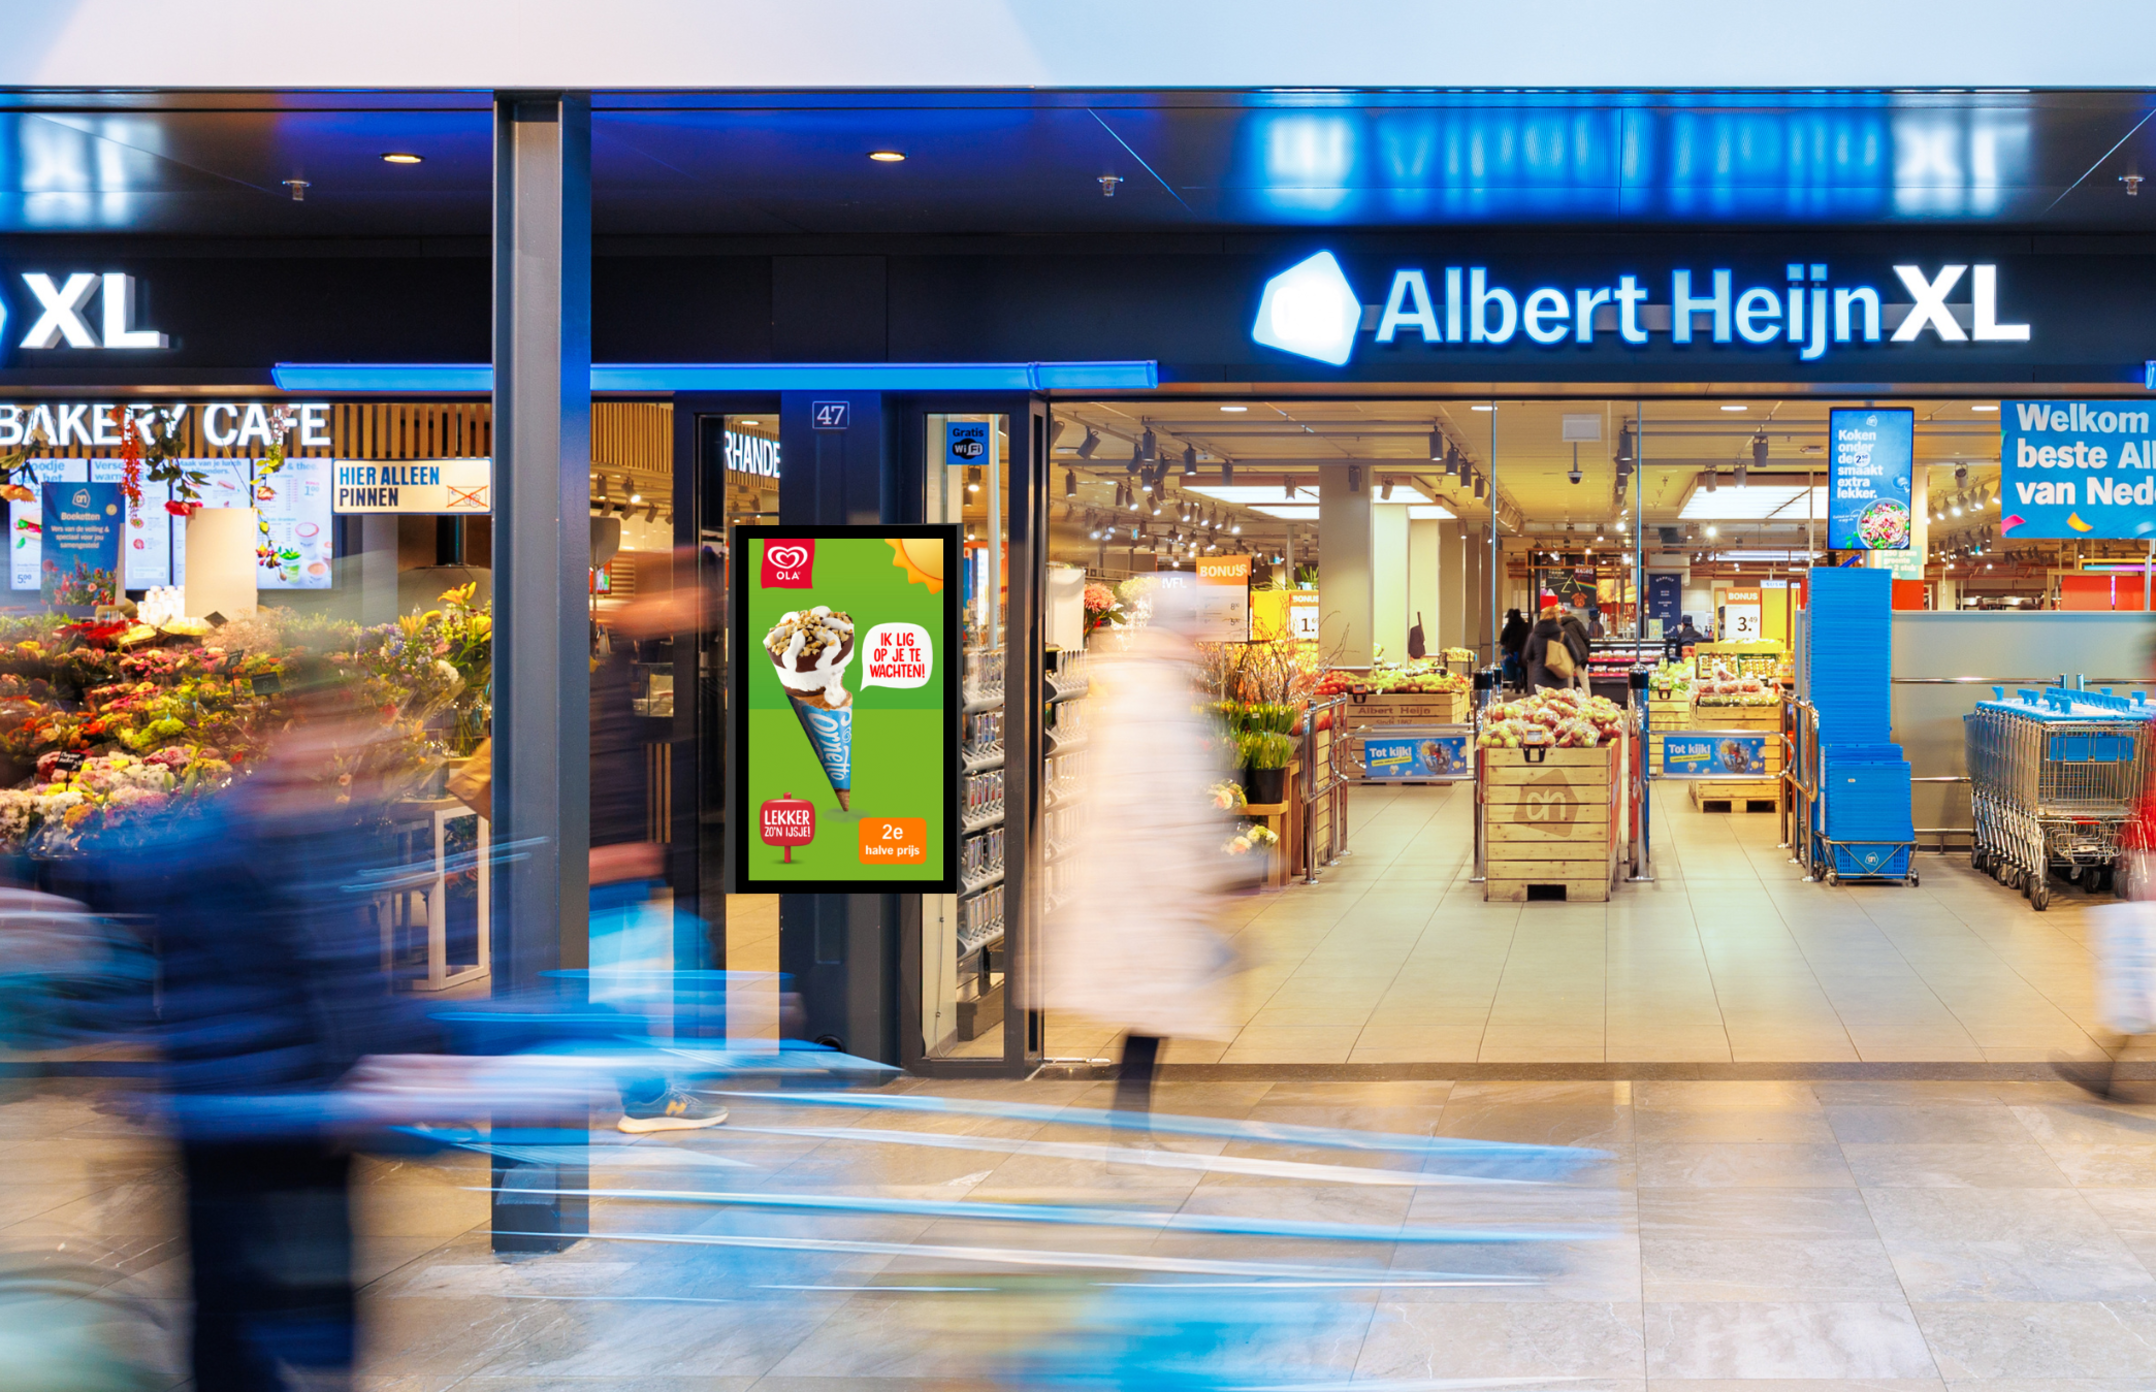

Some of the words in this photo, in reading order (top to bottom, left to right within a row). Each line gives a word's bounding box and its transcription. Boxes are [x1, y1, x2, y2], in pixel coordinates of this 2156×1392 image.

[19, 272, 166, 349] XL
[1374, 266, 1648, 344] Albert
[1672, 263, 1881, 360] Heijn
[1890, 263, 2031, 342] XL
[816, 405, 845, 425] 47
[2016, 403, 2149, 434] Welkom
[0, 403, 187, 446] BAKERY
[203, 403, 331, 446] CAFE
[952, 428, 984, 437] Gratis
[1838, 429, 1876, 440] Koken
[1838, 442, 1874, 452] onder
[2017, 438, 2108, 469] beste
[1838, 453, 1853, 464] de
[31, 459, 65, 473] oodje
[1837, 464, 1883, 476] smaakt
[339, 466, 377, 485] HIER
[380, 466, 440, 486] ALLEEN
[1837, 476, 1870, 487] extra
[339, 487, 399, 507] PINNEN
[1836, 487, 1878, 499] lekker.
[2015, 481, 2076, 505] van
[2087, 475, 2156, 506] Ned
[61, 512, 101, 521] Boeketten
[776, 571, 801, 581] OLA
[1200, 564, 1247, 578] BONUS
[1292, 594, 1319, 603] BONUS
[1728, 592, 1758, 600] BONUS
[880, 632, 893, 647] IK
[896, 632, 914, 647] LIG
[873, 648, 888, 662] OP
[892, 648, 905, 662] JE
[909, 648, 921, 662] TE
[869, 664, 925, 678] WACHTEN!
[1357, 707, 1394, 715] Albert
[1400, 707, 1431, 716] Heijn
[1369, 747, 1388, 758] Tot
[1389, 746, 1412, 759] kijk!
[1668, 744, 1686, 754] Tot
[1688, 743, 1711, 755] kijk!
[764, 810, 810, 826] LEKKER
[764, 826, 783, 837] ZO'N
[785, 826, 811, 837] IJSJE!
[881, 823, 904, 840] 2e
[865, 844, 894, 855] halve
[897, 844, 920, 857] prijs
